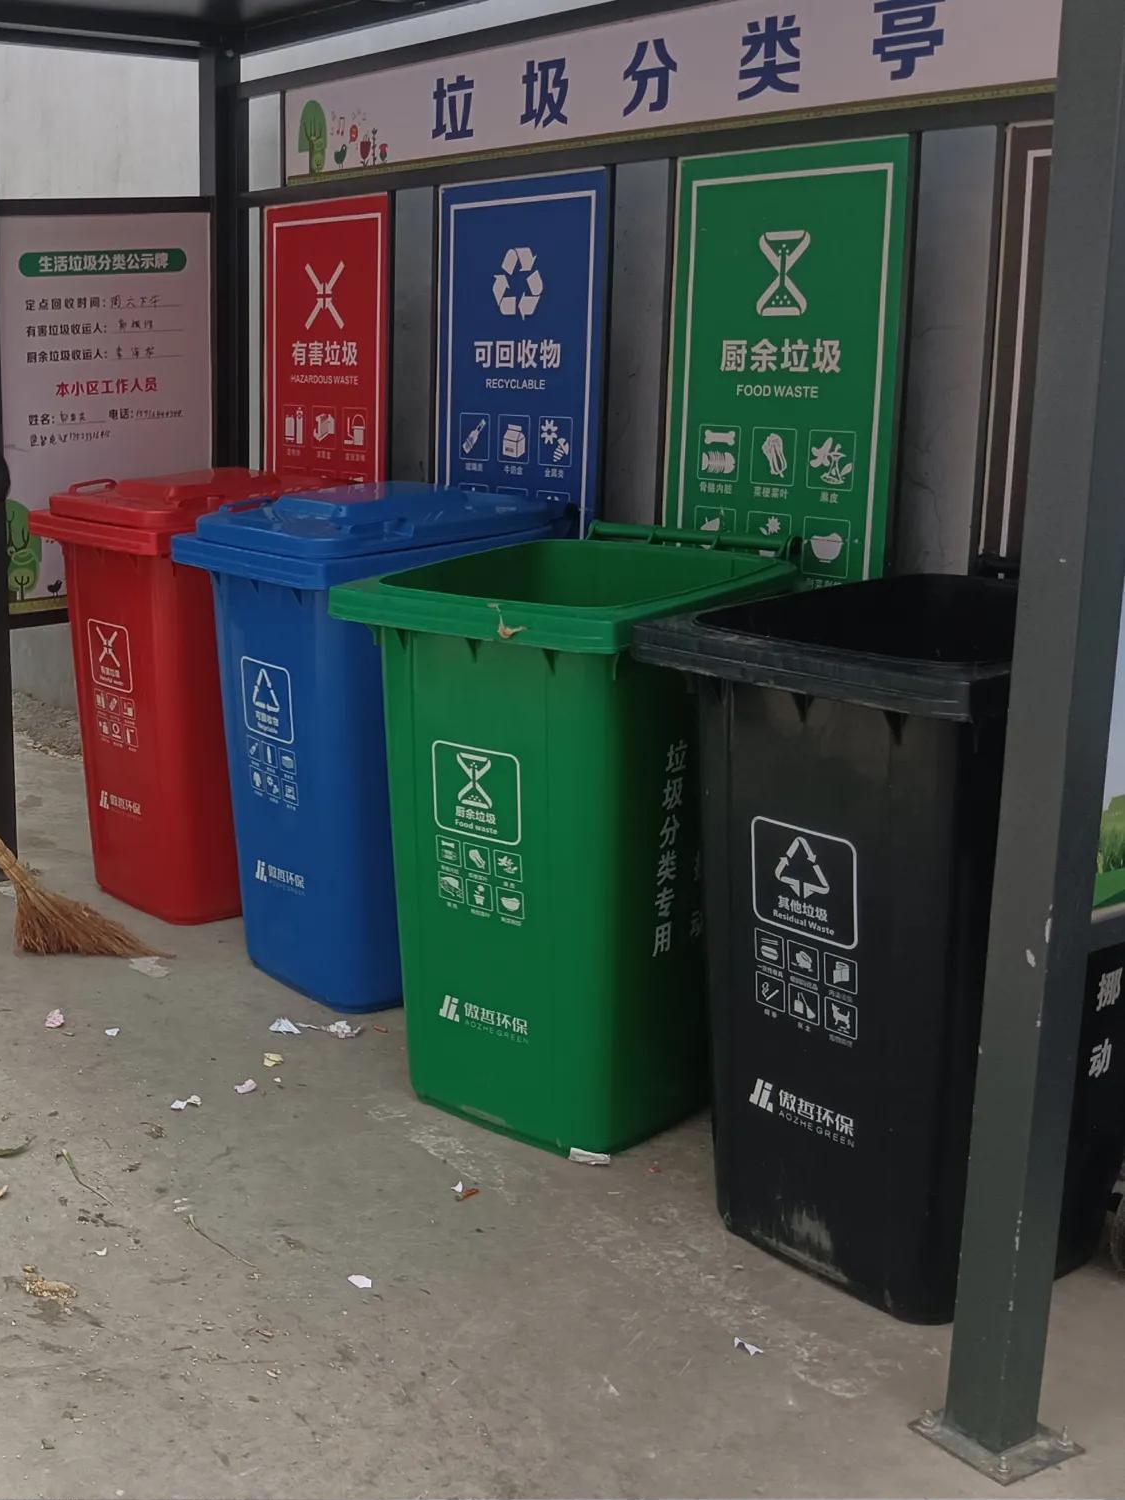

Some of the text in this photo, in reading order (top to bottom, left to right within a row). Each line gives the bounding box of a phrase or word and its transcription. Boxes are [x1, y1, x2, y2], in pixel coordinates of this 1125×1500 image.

[432, 0, 945, 141] 垃圾分类亭
[38, 252, 169, 273] 生活垃圾分类公示牌
[291, 340, 358, 367] 有害垃圾
[473, 338, 562, 369] 可回收物
[720, 338, 842, 374] 厨余垃圾
[55, 377, 158, 398] 本小区工作人员
[290, 374, 359, 386] HAZARDOUS WASTE
[485, 378, 546, 390] RECYCLABLE
[736, 384, 820, 399] FOOD WASTE
[455, 805, 496, 825] 厨余垃圾
[455, 818, 498, 835] Food waste
[652, 739, 688, 957] 垃圾分类专用
[777, 894, 828, 923] 其他垃圾
[772, 909, 835, 936] Residual Waste
[779, 1110, 855, 1149] AOZHE GREEN
